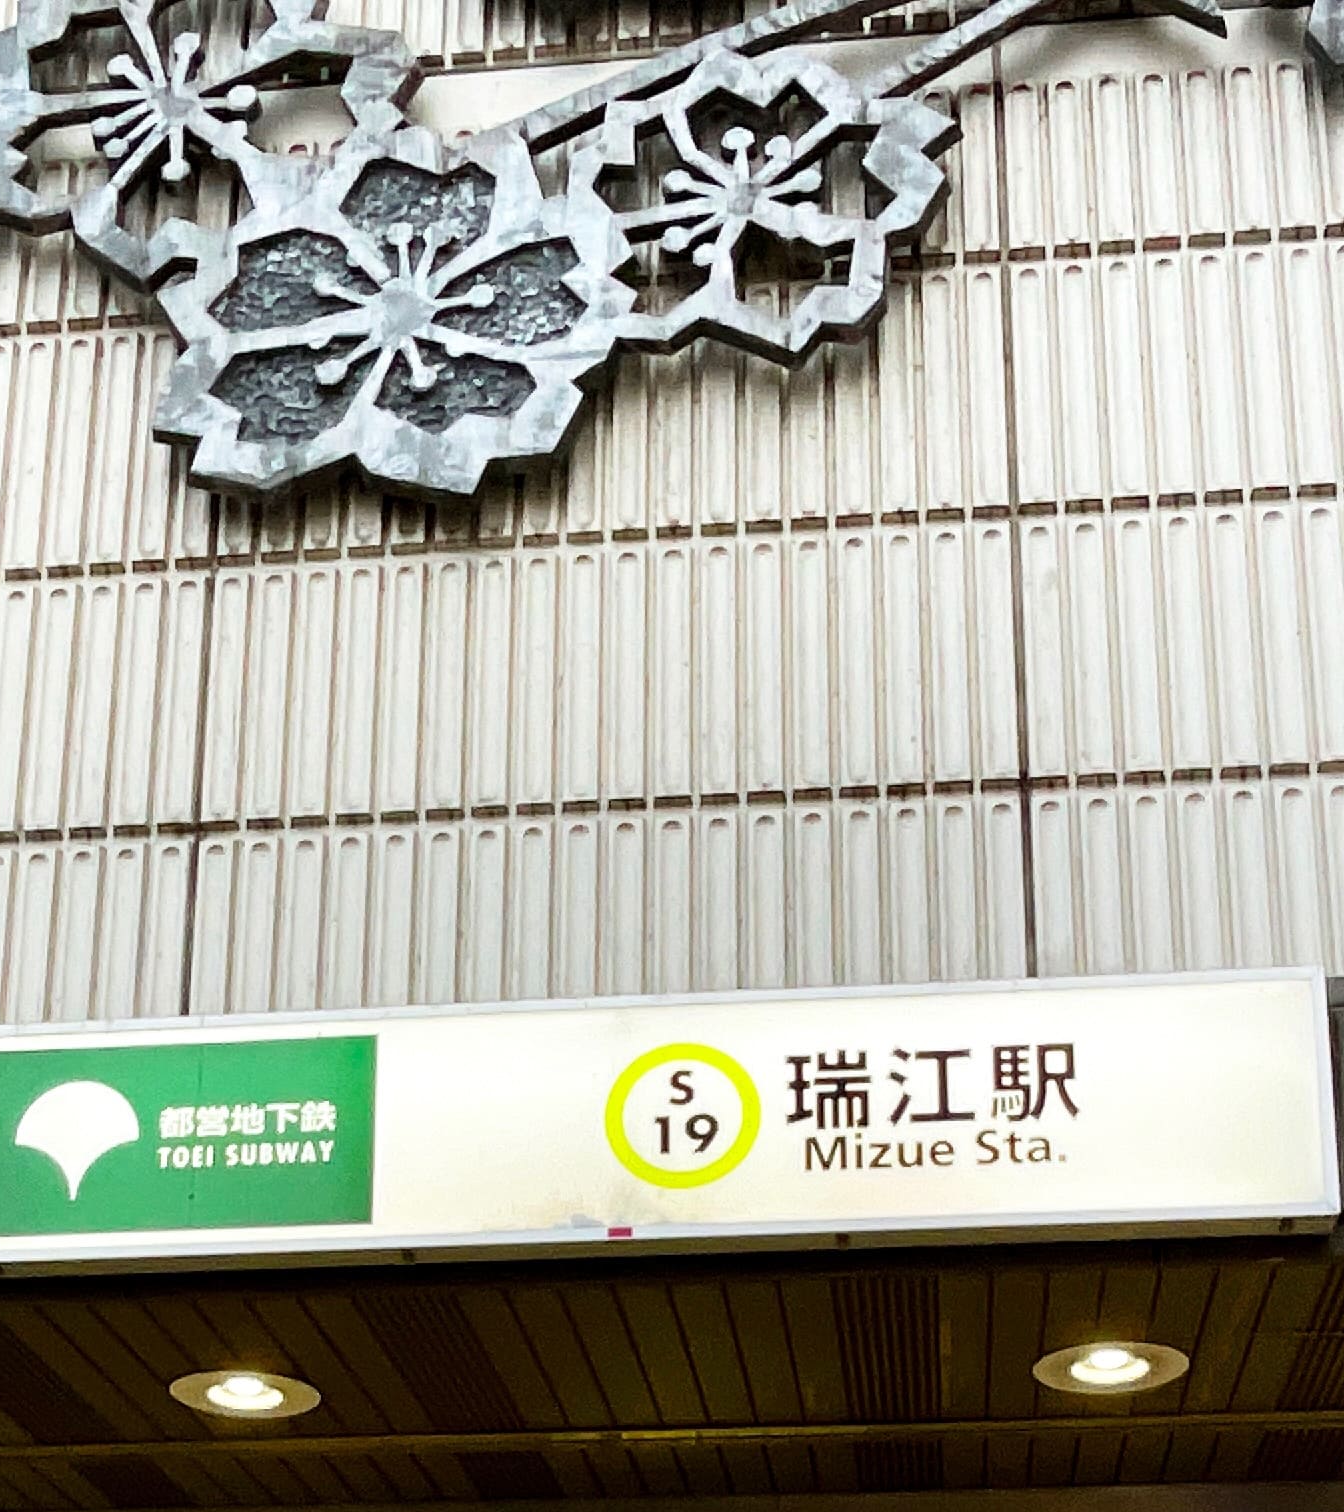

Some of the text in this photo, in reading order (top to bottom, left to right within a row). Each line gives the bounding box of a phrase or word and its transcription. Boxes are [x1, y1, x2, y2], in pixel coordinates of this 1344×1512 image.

[669, 1070, 694, 1105] S
[785, 1043, 1080, 1129] 瑞江駅
[159, 1101, 337, 1139] 都営地下鉄
[655, 1114, 719, 1154] 19
[156, 1140, 334, 1168] TOEI SUBWAY
[805, 1130, 1067, 1170] Mizue Sta.
